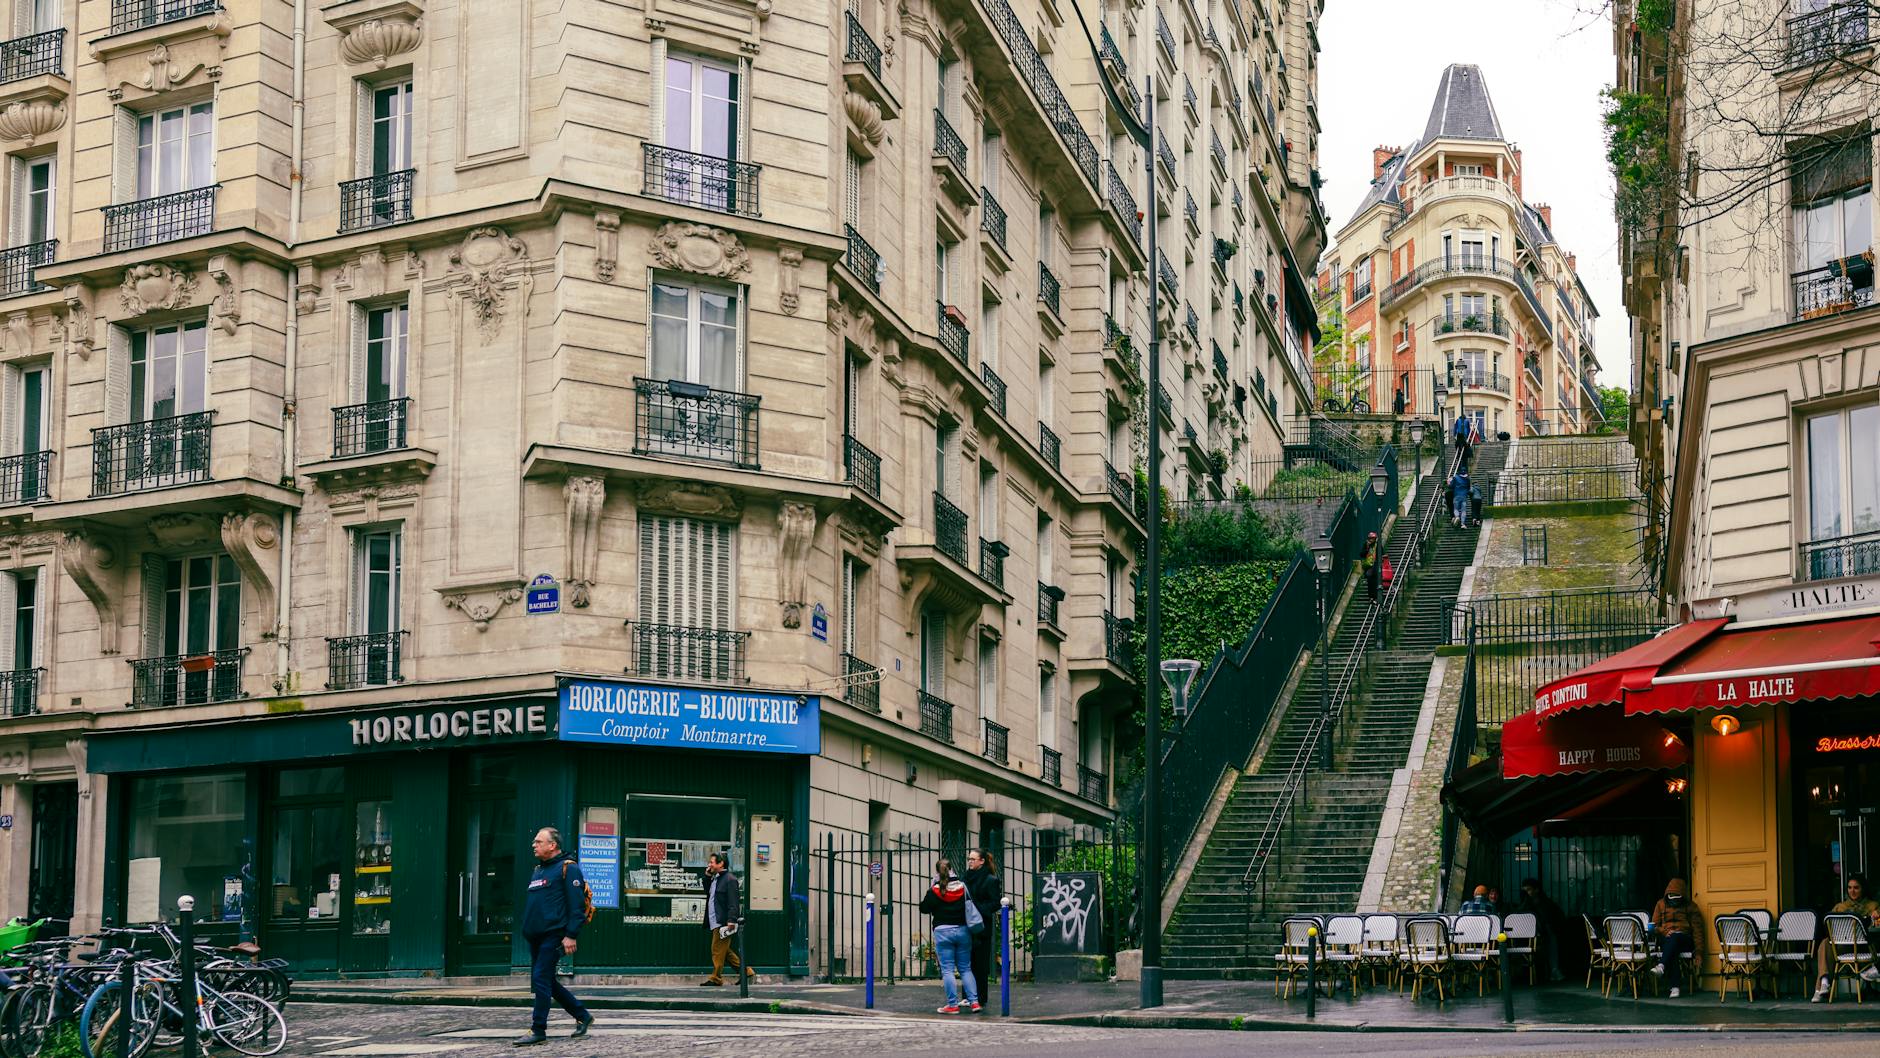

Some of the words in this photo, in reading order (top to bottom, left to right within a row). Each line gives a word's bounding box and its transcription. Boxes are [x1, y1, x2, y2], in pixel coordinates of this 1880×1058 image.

[528, 601, 558, 609] BACHELET
[1792, 584, 1865, 608] HALTE
[1552, 683, 1587, 706] CONTINU
[1718, 683, 1737, 701] LA
[1748, 678, 1794, 698] HALTE
[568, 685, 680, 717] HORLOGERIE
[700, 694, 799, 725] BIJOUTERIE
[352, 705, 546, 745] HORLOGERIE
[602, 718, 669, 741] Comptoir
[680, 724, 766, 746] Montmartre
[1559, 749, 1595, 766] HAPPY
[1606, 747, 1640, 762] HOURS
